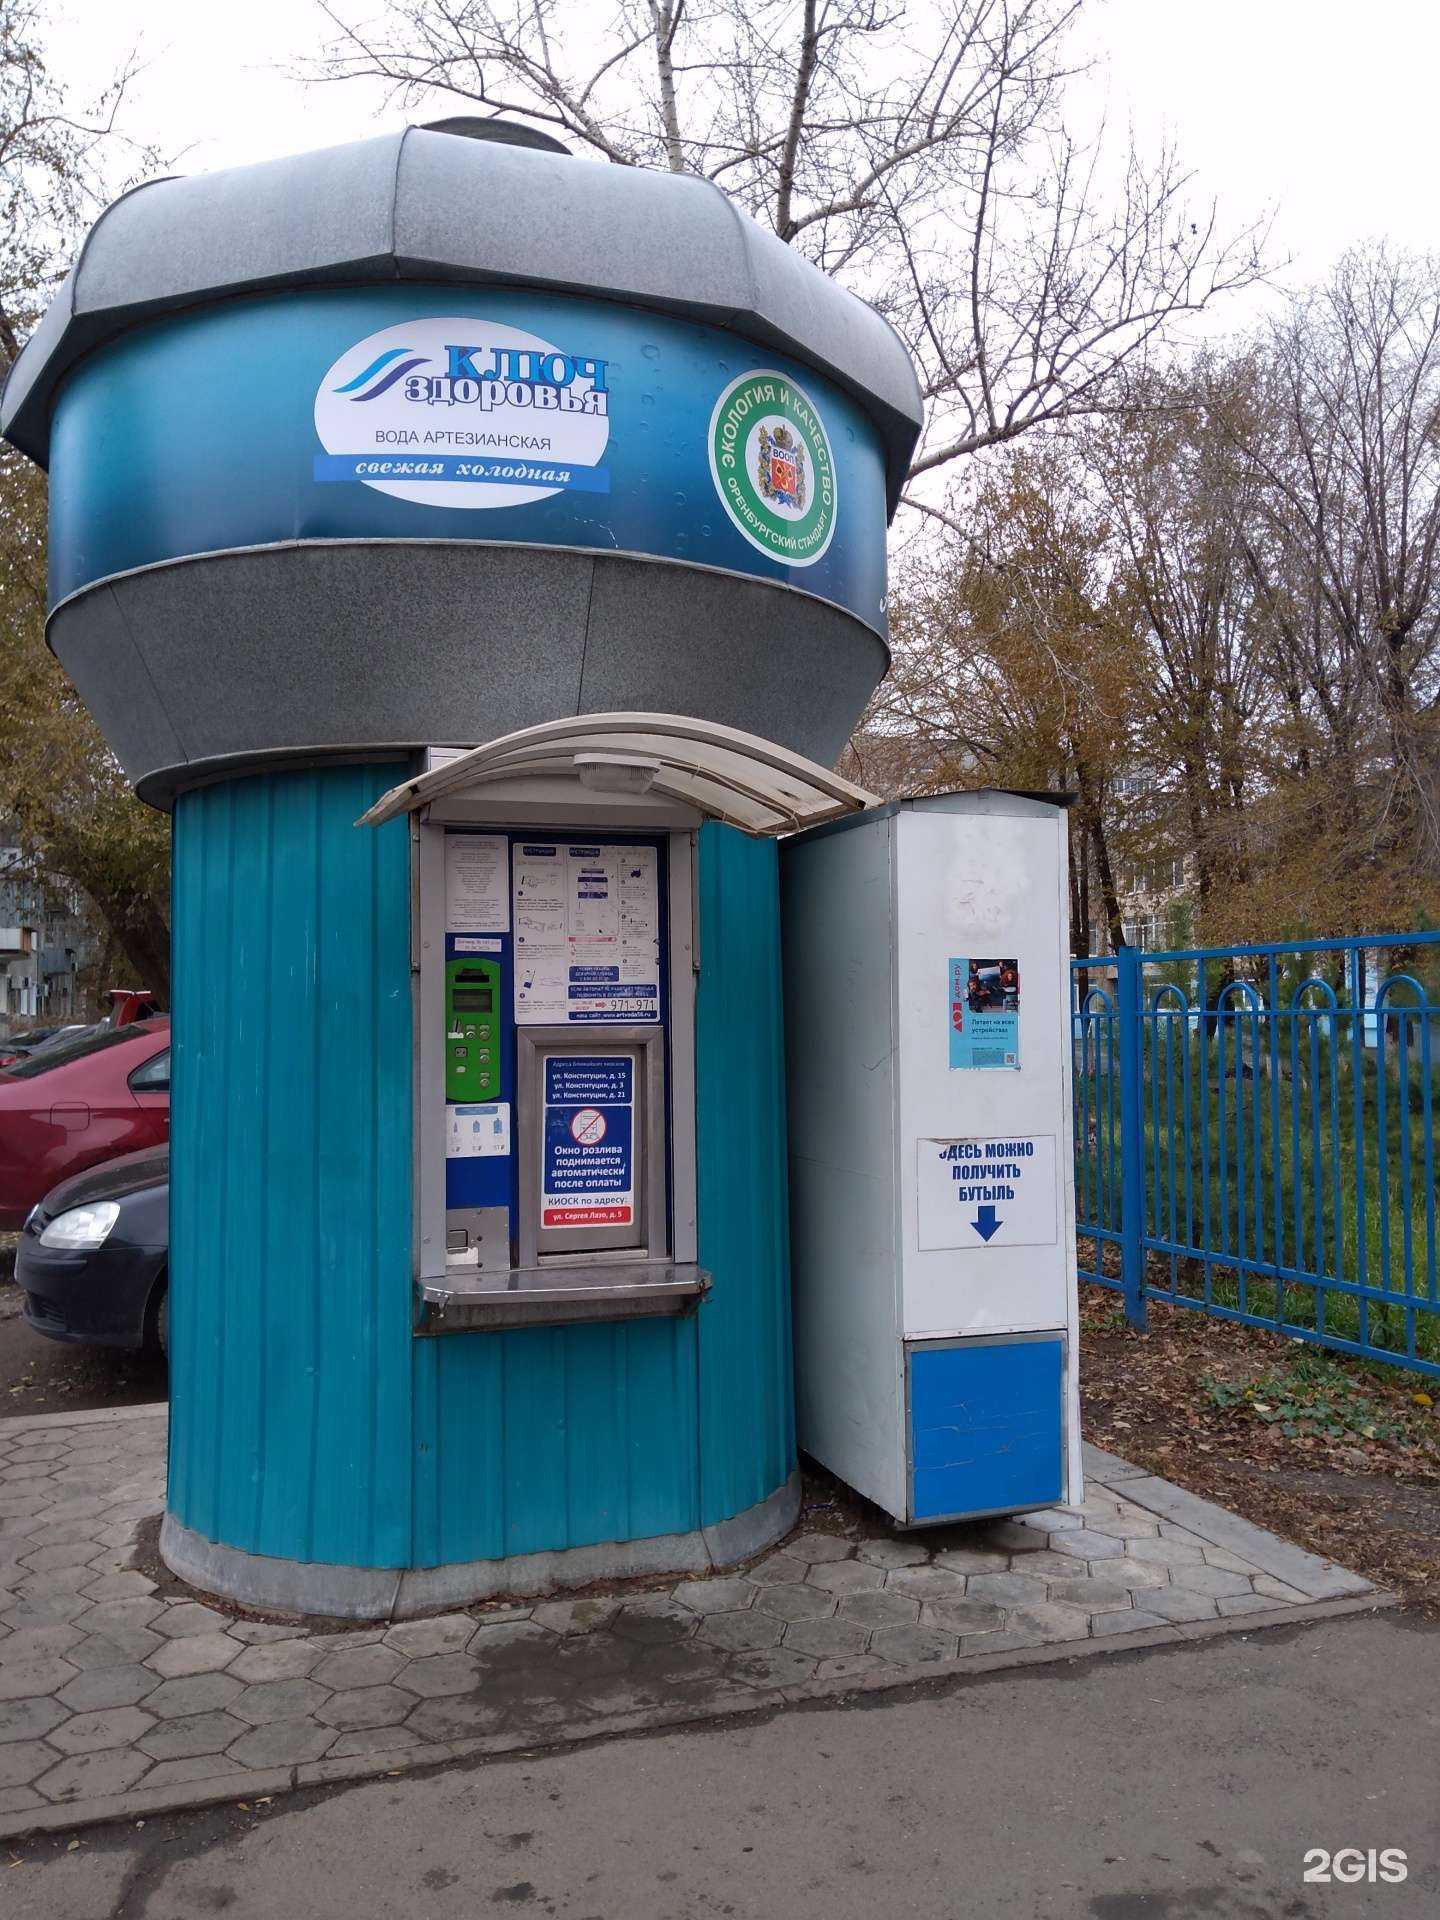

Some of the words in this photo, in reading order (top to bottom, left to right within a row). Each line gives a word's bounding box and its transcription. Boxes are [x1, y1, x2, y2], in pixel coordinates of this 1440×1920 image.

[375, 430, 418, 444] ВОДА
[424, 431, 551, 450] АРТЕЗИАНСКАЯ
[722, 384, 776, 469] ЭКОЛОГИЯ
[780, 388, 791, 404] И
[793, 402, 832, 506] КАЧЕСТВО
[355, 461, 445, 475] свежая
[456, 462, 571, 482] холодная
[728, 477, 797, 550] ОРЕНБУРГСКИЙ
[798, 510, 828, 550] СТАНДАРТ
[554, 1146, 580, 1155] Окно
[582, 1146, 623, 1156] розлива
[985, 1142, 1034, 1158] МОЖНО
[556, 1157, 621, 1167] поднимается
[551, 1167, 625, 1177] автоматически
[952, 1164, 1021, 1180] ПОЛУЧИТЬ
[554, 1180, 584, 1188] после
[586, 1179, 621, 1187] оплаты
[959, 1185, 1015, 1201] БУТЫЛЬ
[548, 1197, 579, 1206] КИОСК
